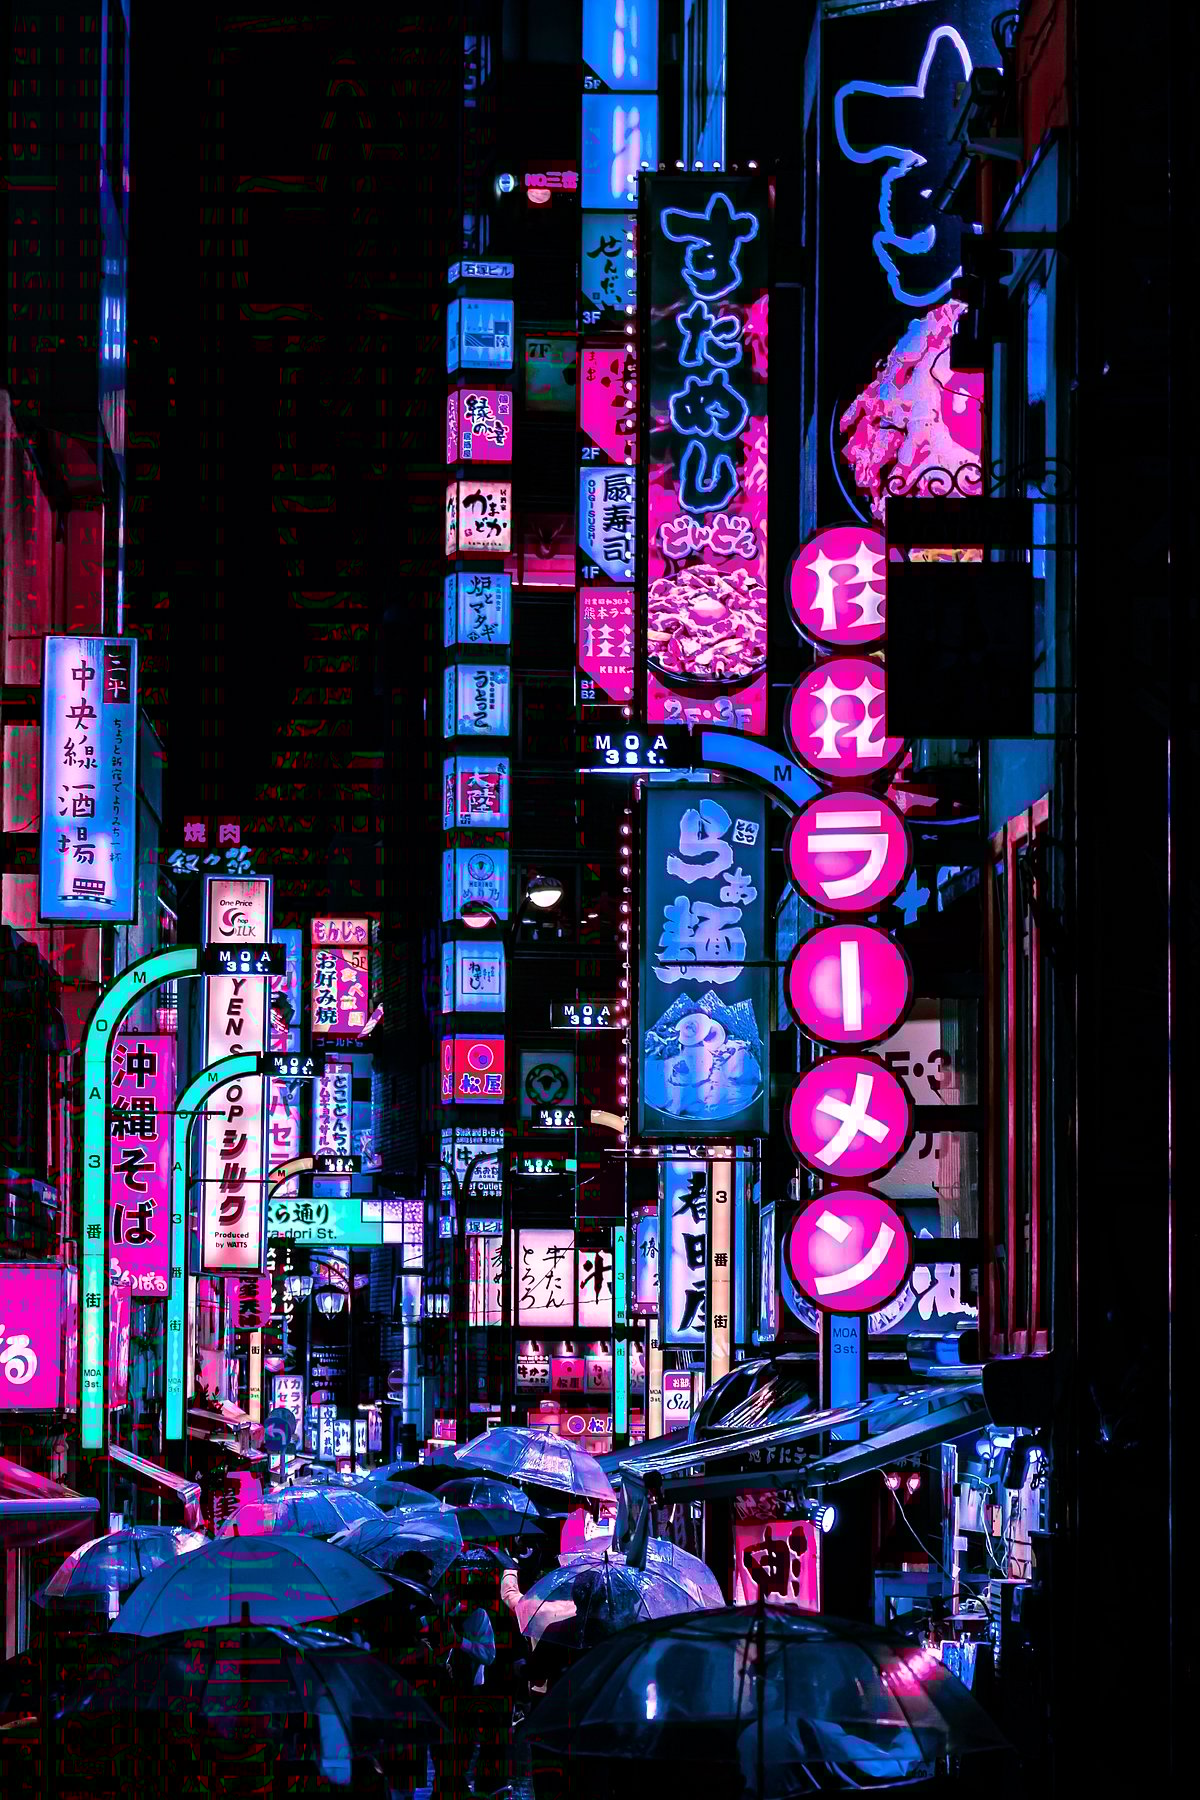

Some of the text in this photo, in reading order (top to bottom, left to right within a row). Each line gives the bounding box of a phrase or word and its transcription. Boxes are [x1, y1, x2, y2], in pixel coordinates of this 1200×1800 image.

[463, 263, 511, 277] 石塚ビル
[583, 312, 601, 324] 3F
[660, 191, 758, 513] すためし
[582, 446, 601, 459] 2F
[462, 488, 508, 538] かまどか
[602, 473, 632, 563] 扇寿司
[582, 566, 600, 579] 1F
[466, 576, 499, 641] 炉とマタギ
[106, 652, 129, 700] 三平
[582, 681, 595, 690] B1
[582, 690, 596, 700] B2
[596, 735, 668, 750] MOA
[57, 658, 98, 866] 中央線酒場
[184, 822, 241, 844] 焼肉
[219, 899, 252, 908] One Price
[314, 921, 367, 943] もんじゃ
[219, 950, 271, 963] MOA
[351, 951, 366, 968] 5F
[313, 950, 338, 1026] お好み焼
[564, 1006, 610, 1016] MOA
[225, 978, 246, 1123] YEN SOP
[275, 1058, 314, 1067] MOA
[458, 1073, 503, 1095] 松屋
[541, 1110, 576, 1119] MOA
[110, 1042, 159, 1246] 沖縄そば
[325, 1158, 353, 1166] MOA
[219, 1130, 247, 1226] シルク
[477, 1182, 503, 1191] Cutlet
[214, 1231, 249, 1239] Produced
[317, 1228, 337, 1239] St.
[216, 1240, 248, 1251] by WATTS
[520, 1245, 536, 1309] とろろ
[541, 1245, 565, 1309] 牛たん
[832, 1327, 858, 1339] MOA
[83, 1369, 102, 1379] MOA
[672, 1377, 691, 1388] お部
[278, 1378, 289, 1408] パセ
